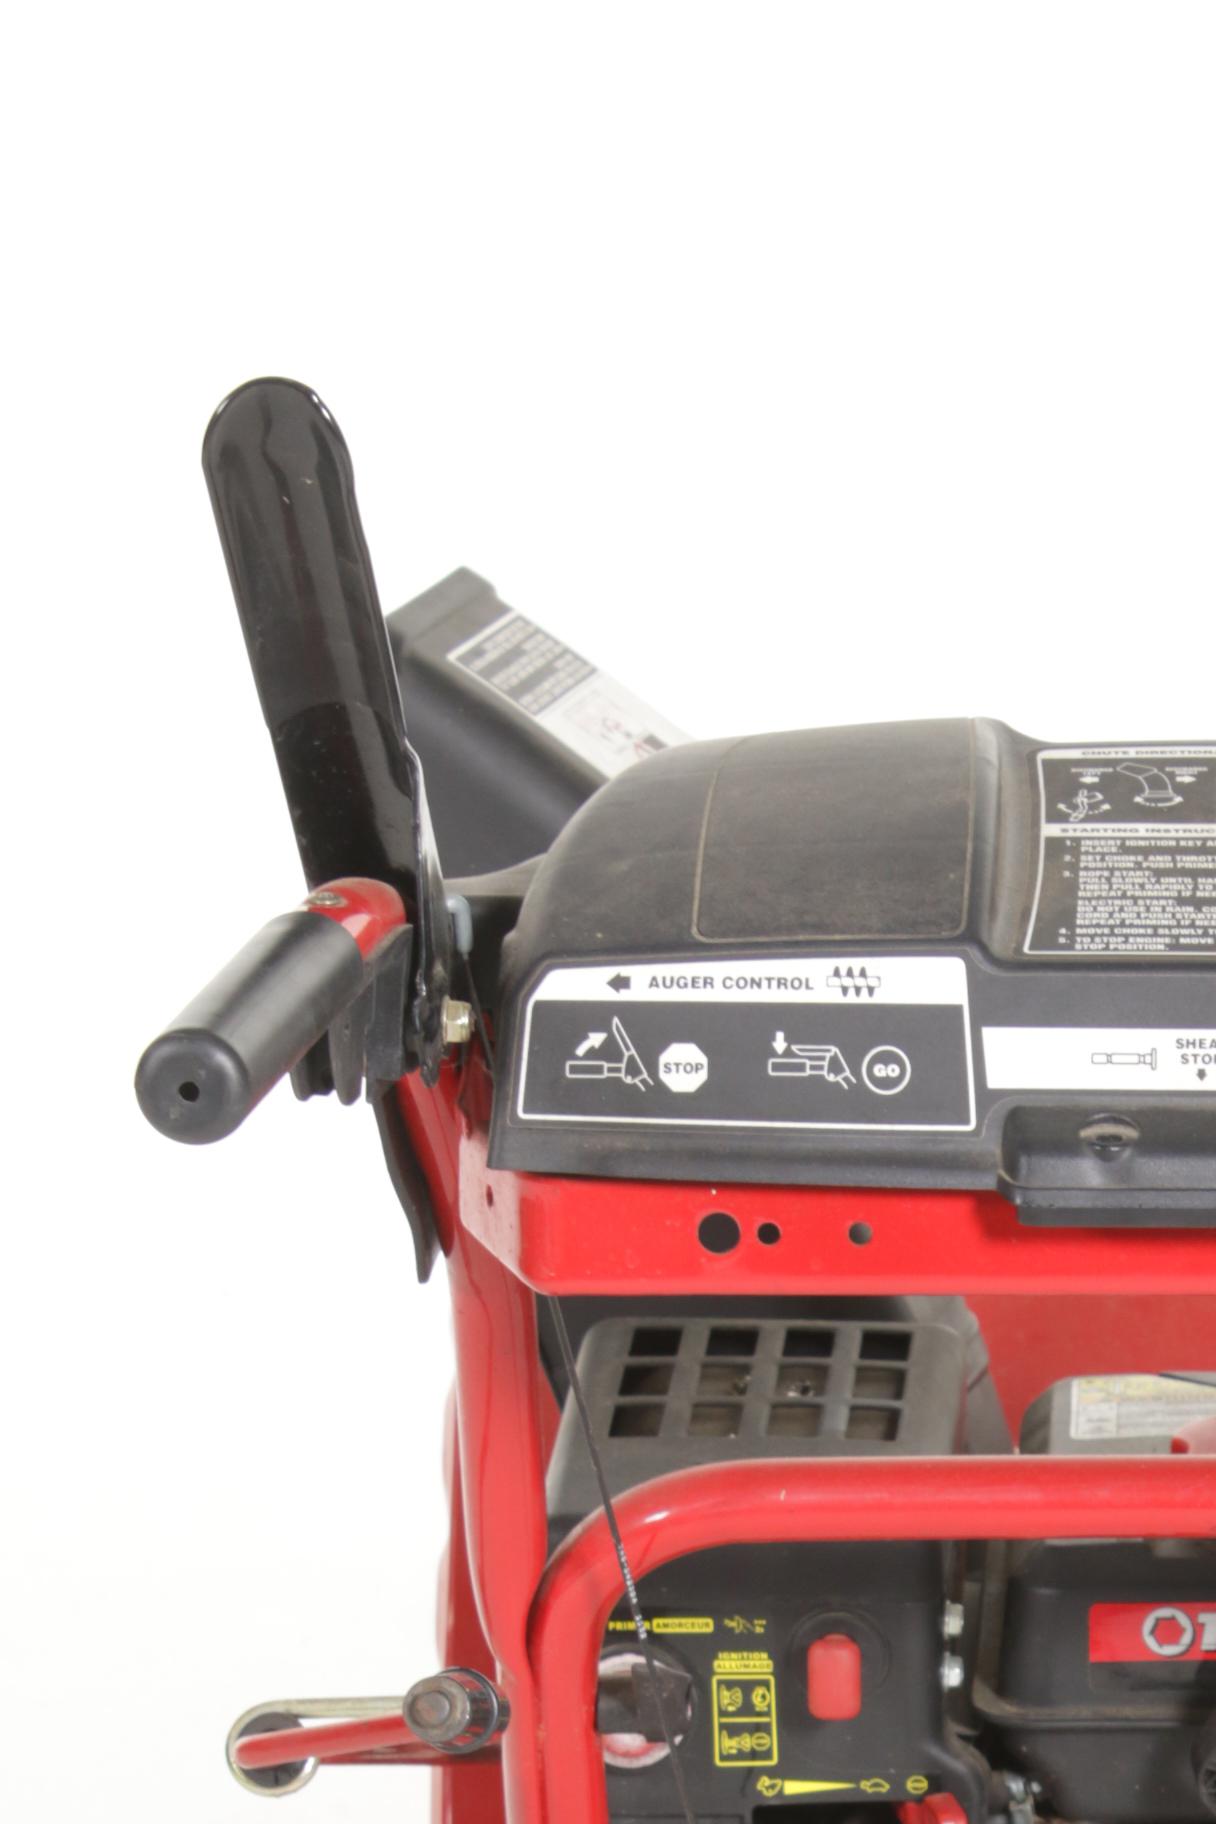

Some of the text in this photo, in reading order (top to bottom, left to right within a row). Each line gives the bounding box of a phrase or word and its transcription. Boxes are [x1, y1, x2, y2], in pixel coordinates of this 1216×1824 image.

[648, 976, 814, 991] AUGER CONTROL
[663, 1062, 704, 1074] STOP
[873, 1064, 900, 1076] GO
[608, 1621, 650, 1631] PRIMR
[655, 1621, 711, 1629] AMORCEUR
[718, 1651, 769, 1660] IGNITION
